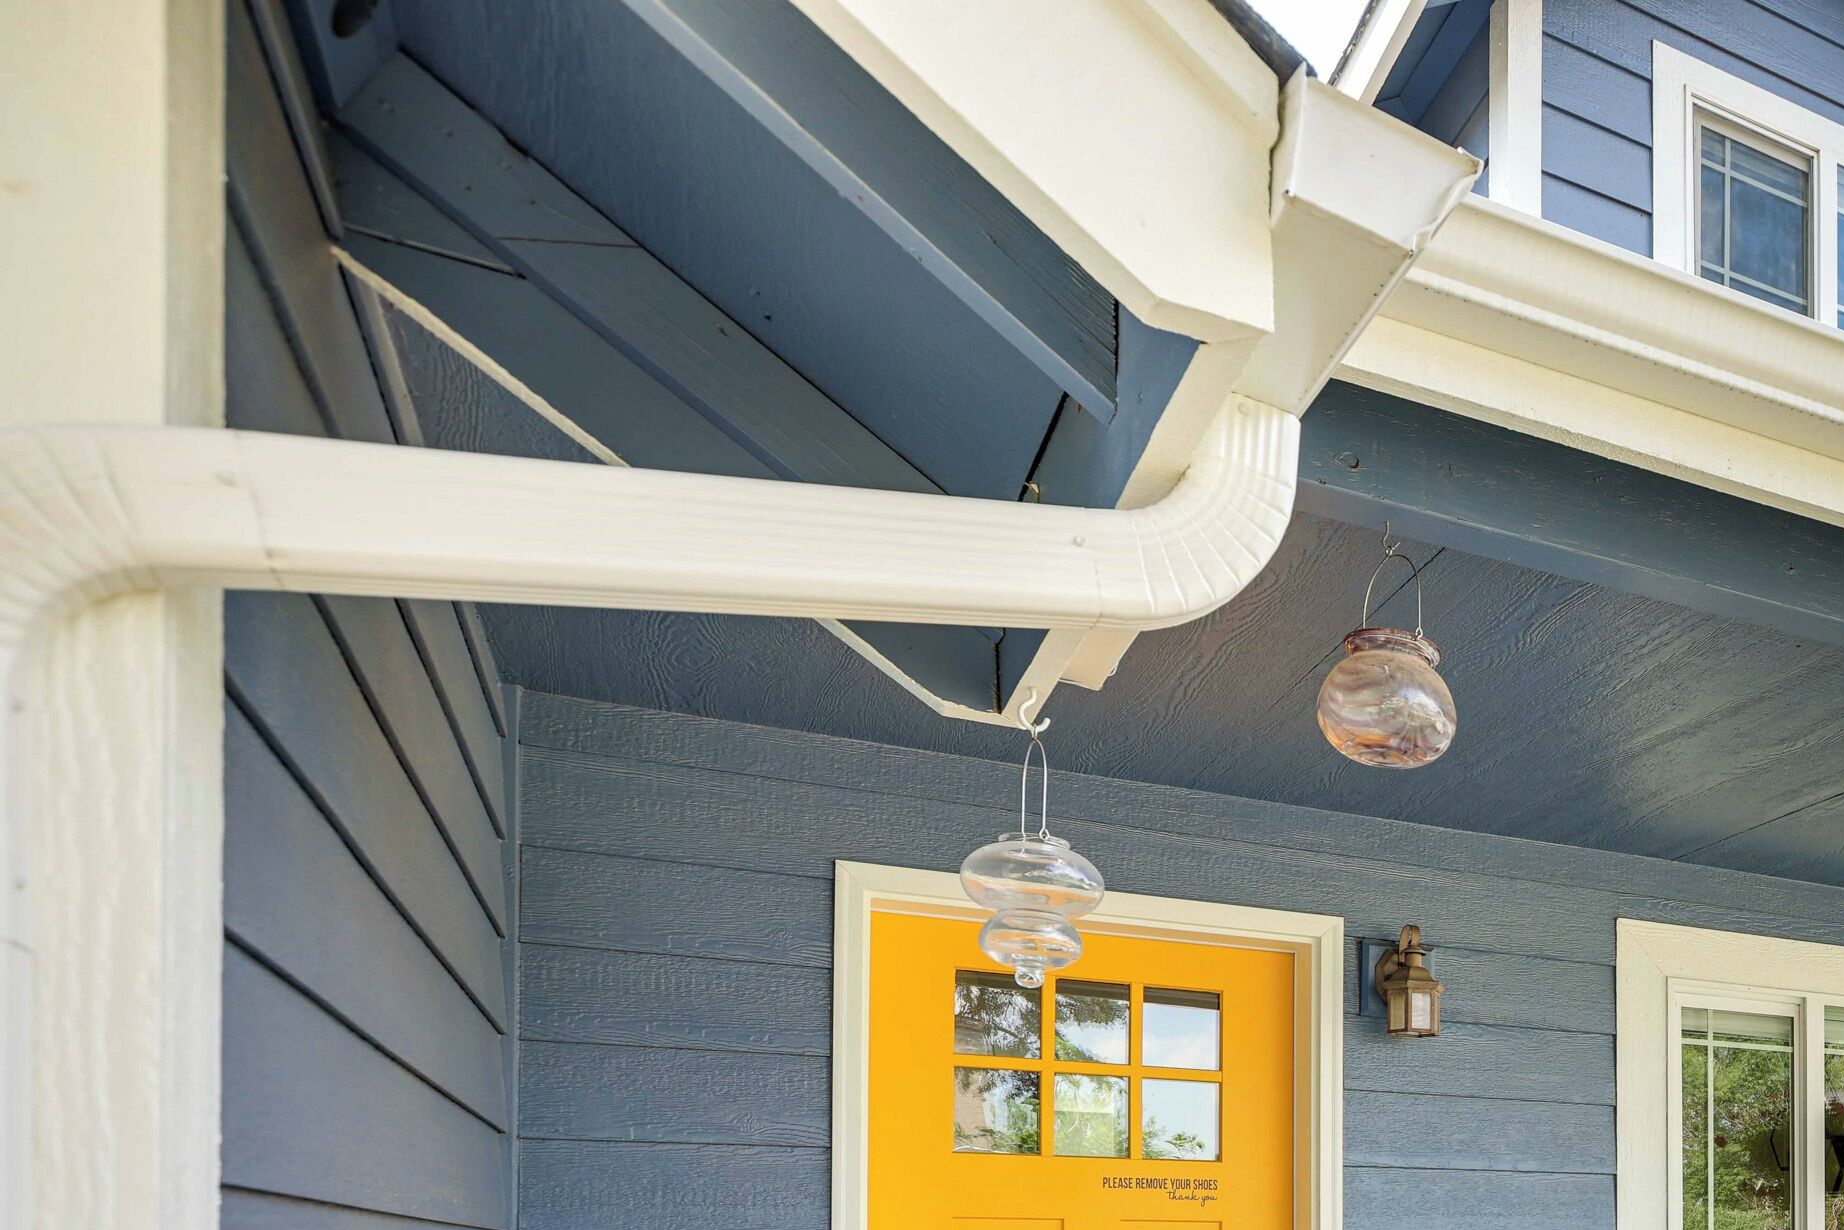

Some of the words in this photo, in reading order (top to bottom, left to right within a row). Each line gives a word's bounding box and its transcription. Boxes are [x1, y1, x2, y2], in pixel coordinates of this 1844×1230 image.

[1102, 1177, 1133, 1188] PLEASE
[1135, 1178, 1168, 1190] REMOVE
[1170, 1178, 1191, 1190] YOUR
[1193, 1179, 1218, 1191] SHOES
[1166, 1189, 1200, 1201] thank
[1200, 1193, 1218, 1207] you
